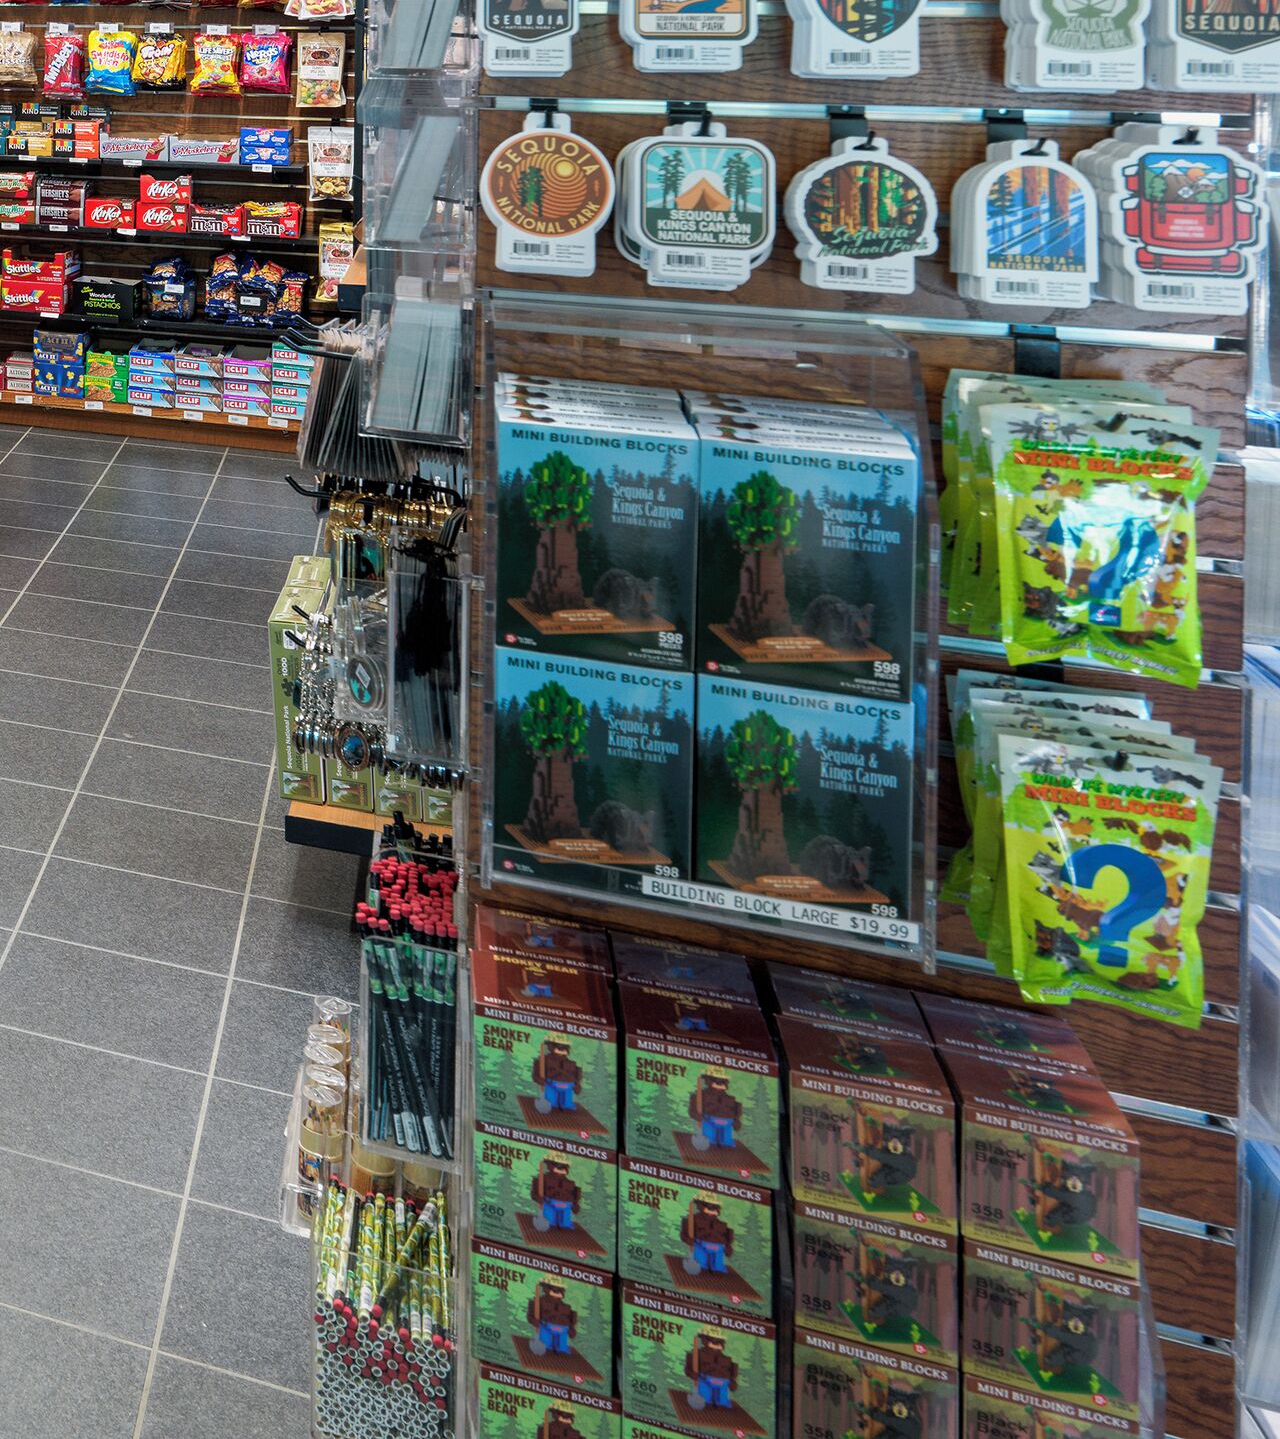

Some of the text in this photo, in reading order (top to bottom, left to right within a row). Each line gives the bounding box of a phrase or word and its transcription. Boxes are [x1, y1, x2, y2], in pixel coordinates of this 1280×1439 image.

[492, 14, 564, 26] SEQUOIA
[655, 21, 725, 32] NATIONAL PARK
[1185, 14, 1279, 31] SEQUOIA
[496, 138, 601, 174] SEQUOIA
[496, 196, 602, 234] NATIONAL PARK
[669, 209, 725, 222] SEQUOIA
[657, 219, 752, 234] KINGS CANYON
[657, 230, 751, 245] NATIONAL PARK
[990, 261, 1084, 273] NATIONAL PARK
[1006, 254, 1067, 264] SEQUOIA
[6, 264, 41, 274] Skittles
[4, 294, 40, 304] Skittles
[84, 300, 121, 310] PISTACHIOS
[136, 358, 153, 366] CLIF
[8, 369, 30, 377] ALTOIDS
[136, 375, 153, 383] CLIF
[8, 382, 30, 391] ALTOIDS
[511, 428, 689, 455] MINI BUILDING BLOCKS
[712, 447, 904, 476] MINI BUILDING BLOCKS
[612, 482, 654, 501] Sequoia
[612, 498, 684, 521] Kings Canyon
[822, 503, 869, 525] Sequoia
[822, 522, 901, 546] Kings Canyon
[658, 632, 683, 645] 598
[507, 656, 683, 691] MINI BUILDING BLOCKS
[873, 661, 901, 675] 598
[285, 746, 293, 769] Sequoia
[1025, 784, 1197, 822] MINI BLOCKS
[651, 880, 910, 939] BUILDING BLOCK LARGE $19.99
[871, 903, 898, 918] 598
[482, 1024, 531, 1044] SMOKEY
[482, 1036, 514, 1053] BEAR
[636, 1057, 687, 1078] SMOKEY
[636, 1069, 669, 1086] BEAR
[800, 1166, 830, 1183] 358
[478, 1261, 526, 1284] SMOKEY
[478, 1274, 509, 1292] BEAR
